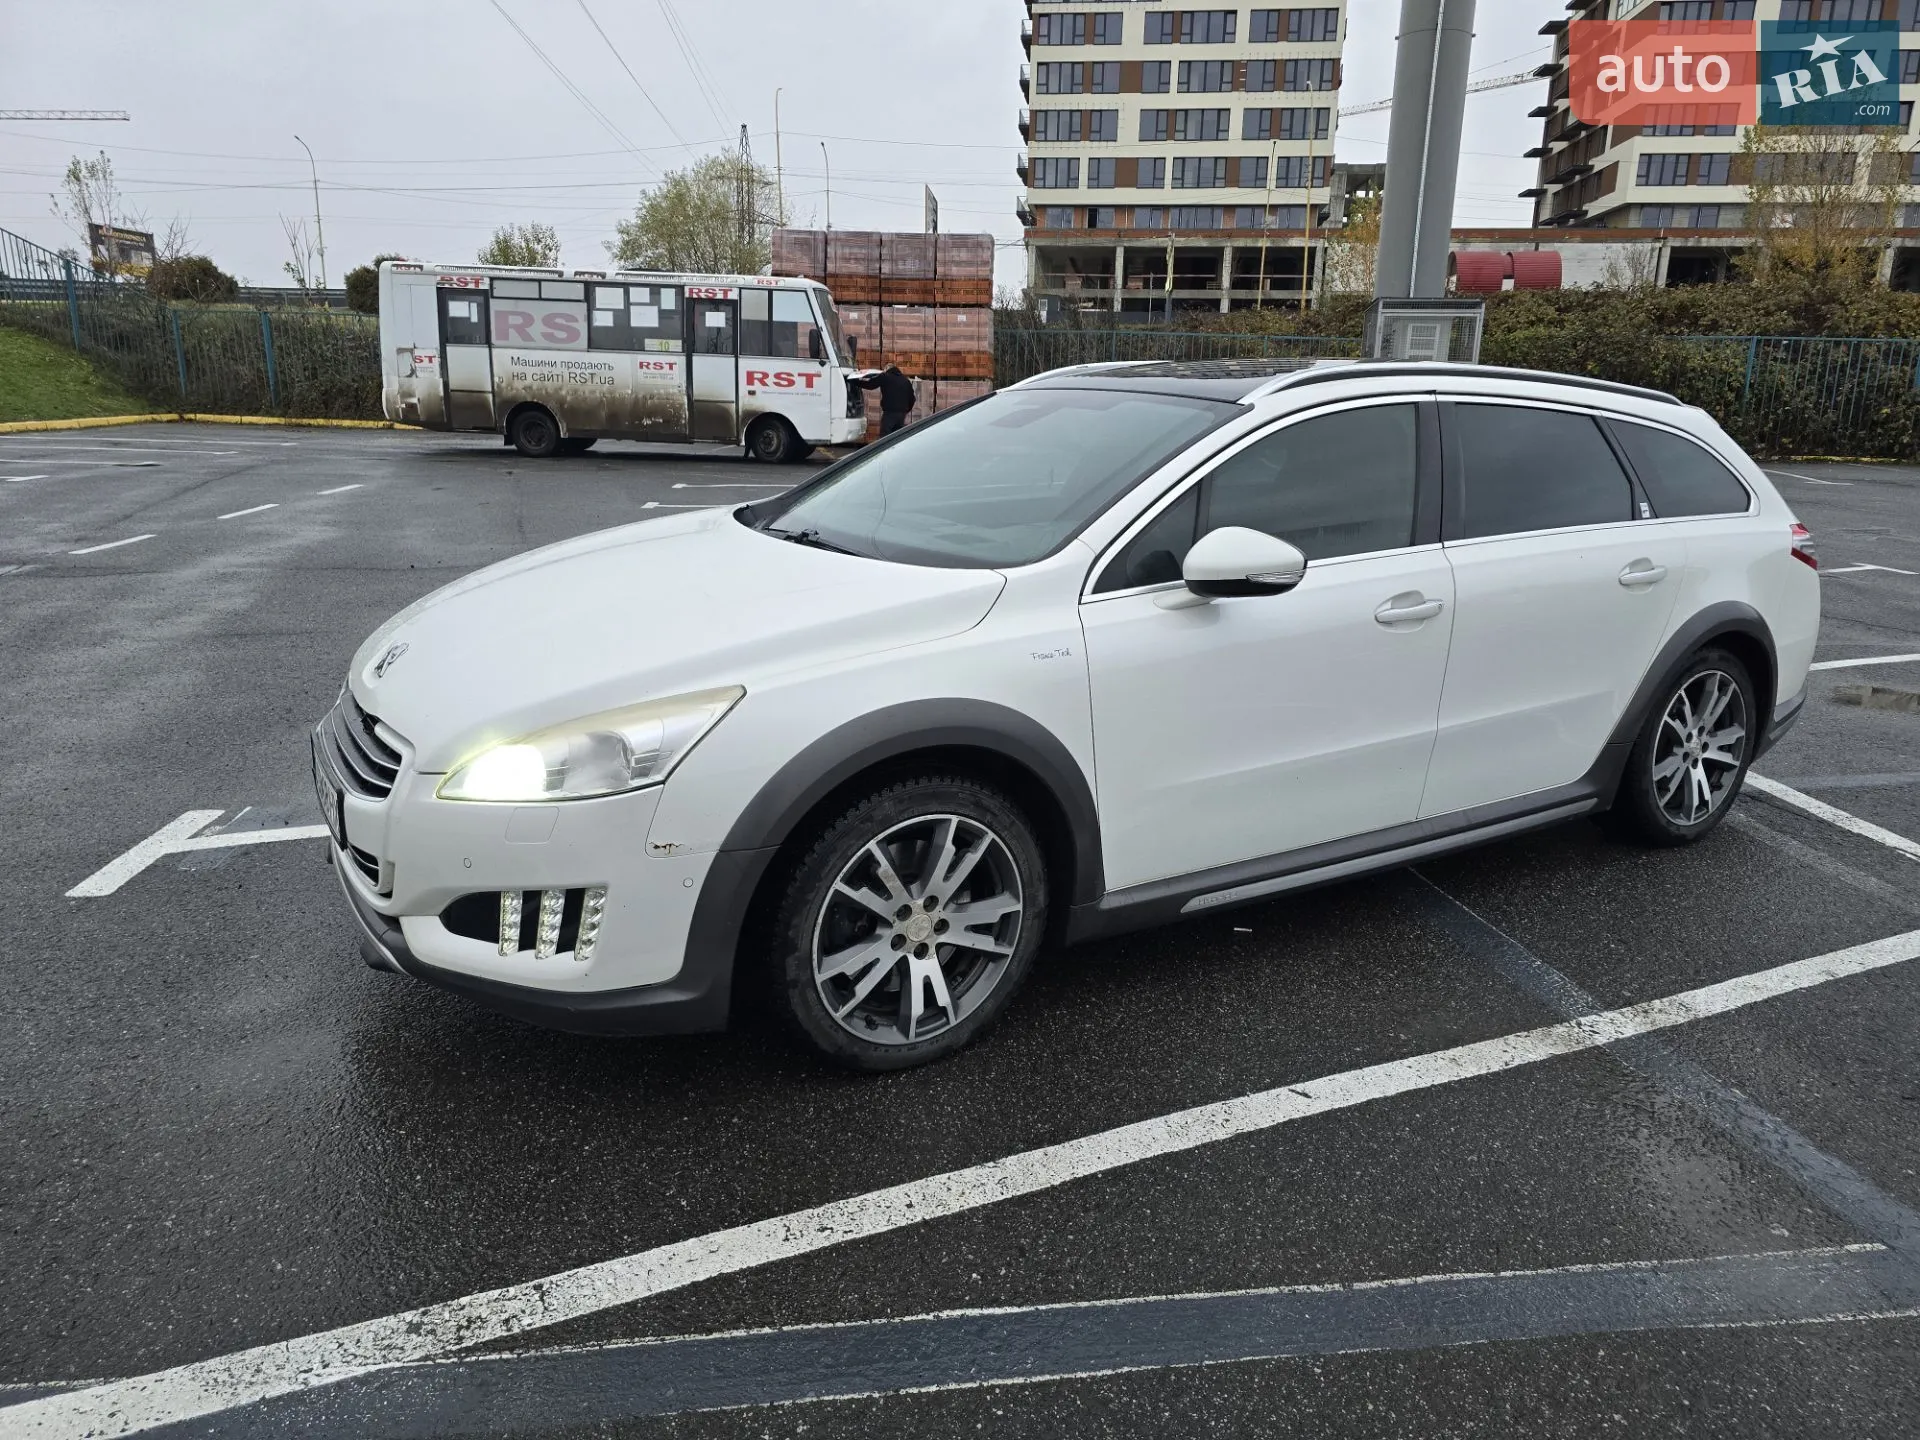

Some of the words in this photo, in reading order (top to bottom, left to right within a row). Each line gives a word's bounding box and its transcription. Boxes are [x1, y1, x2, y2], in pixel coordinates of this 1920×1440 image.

[440, 275, 484, 288] RST
[688, 287, 733, 299] RST
[494, 310, 582, 344] RS
[414, 355, 437, 364] ST
[511, 356, 557, 368] Машини
[560, 360, 614, 371] продають
[639, 361, 677, 371] RST
[512, 372, 527, 381] на
[532, 371, 564, 383] сайті
[569, 372, 615, 386] RST.ua
[746, 370, 822, 389] RST
